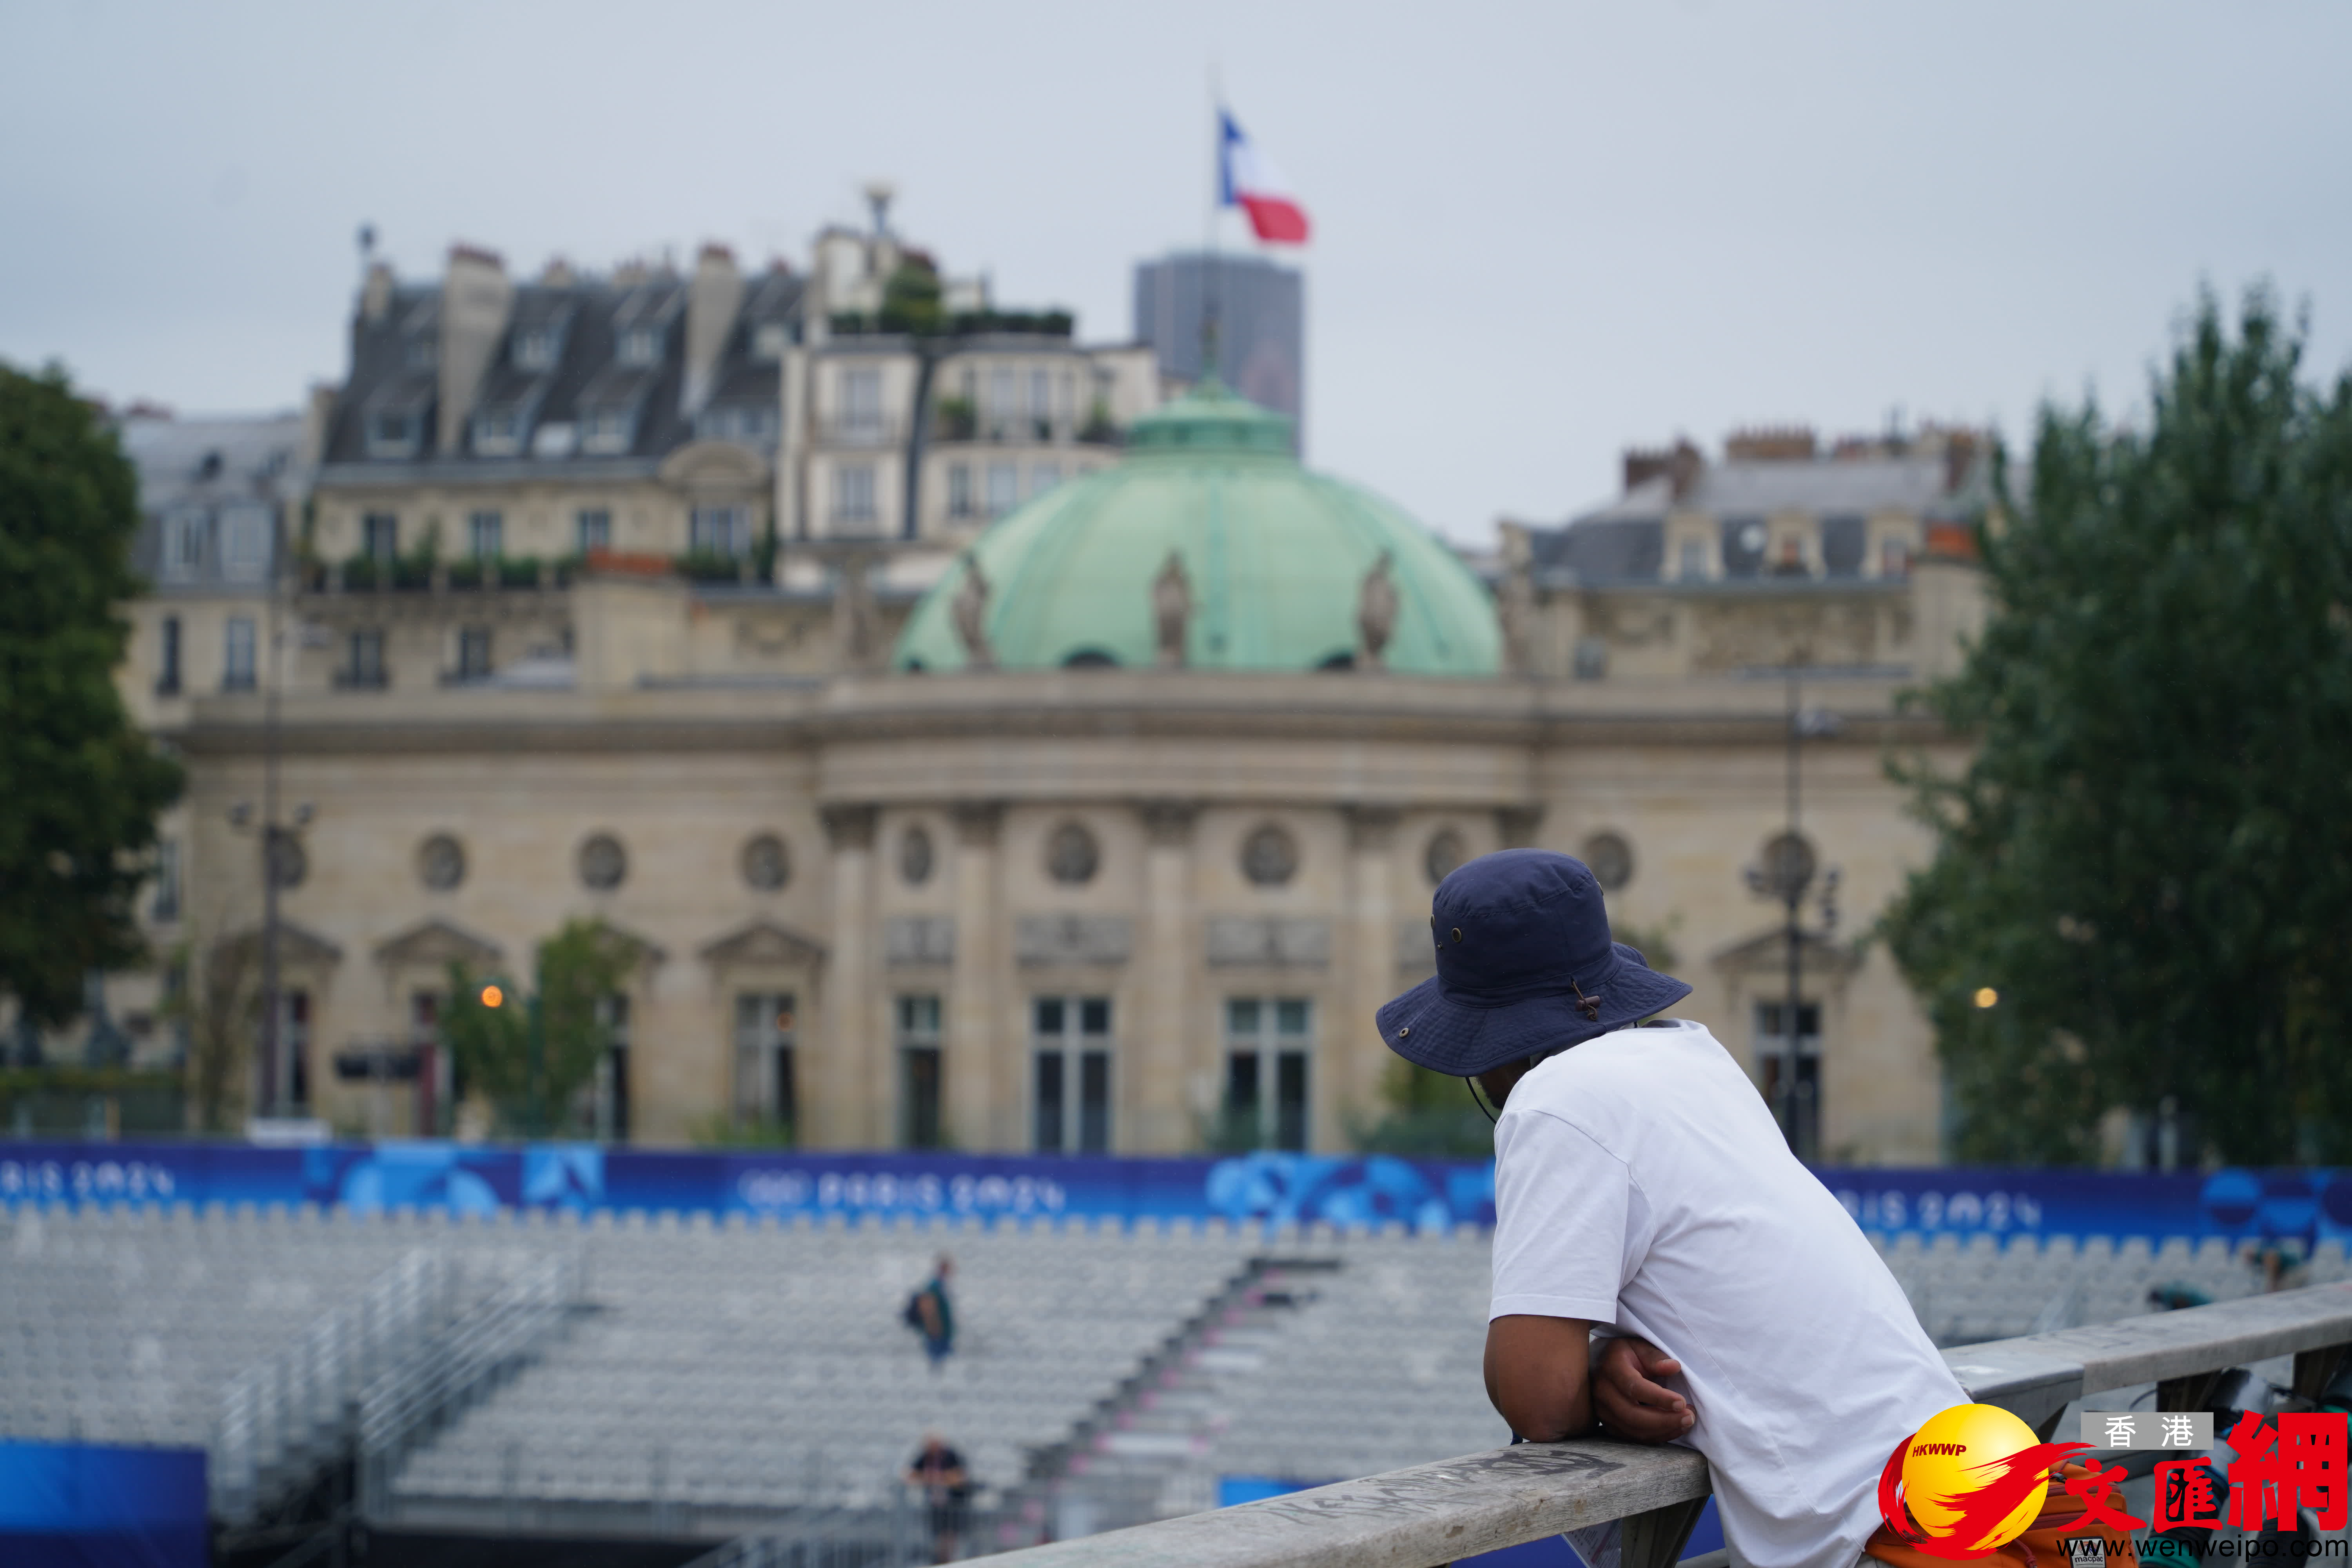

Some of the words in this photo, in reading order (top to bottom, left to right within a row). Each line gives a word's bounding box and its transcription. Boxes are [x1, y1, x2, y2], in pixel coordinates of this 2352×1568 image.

[71, 1160, 176, 1198] 2024
[817, 1172, 940, 1212] PARIS
[949, 1174, 1067, 1214] 2024
[1917, 1191, 2042, 1230] 2024
